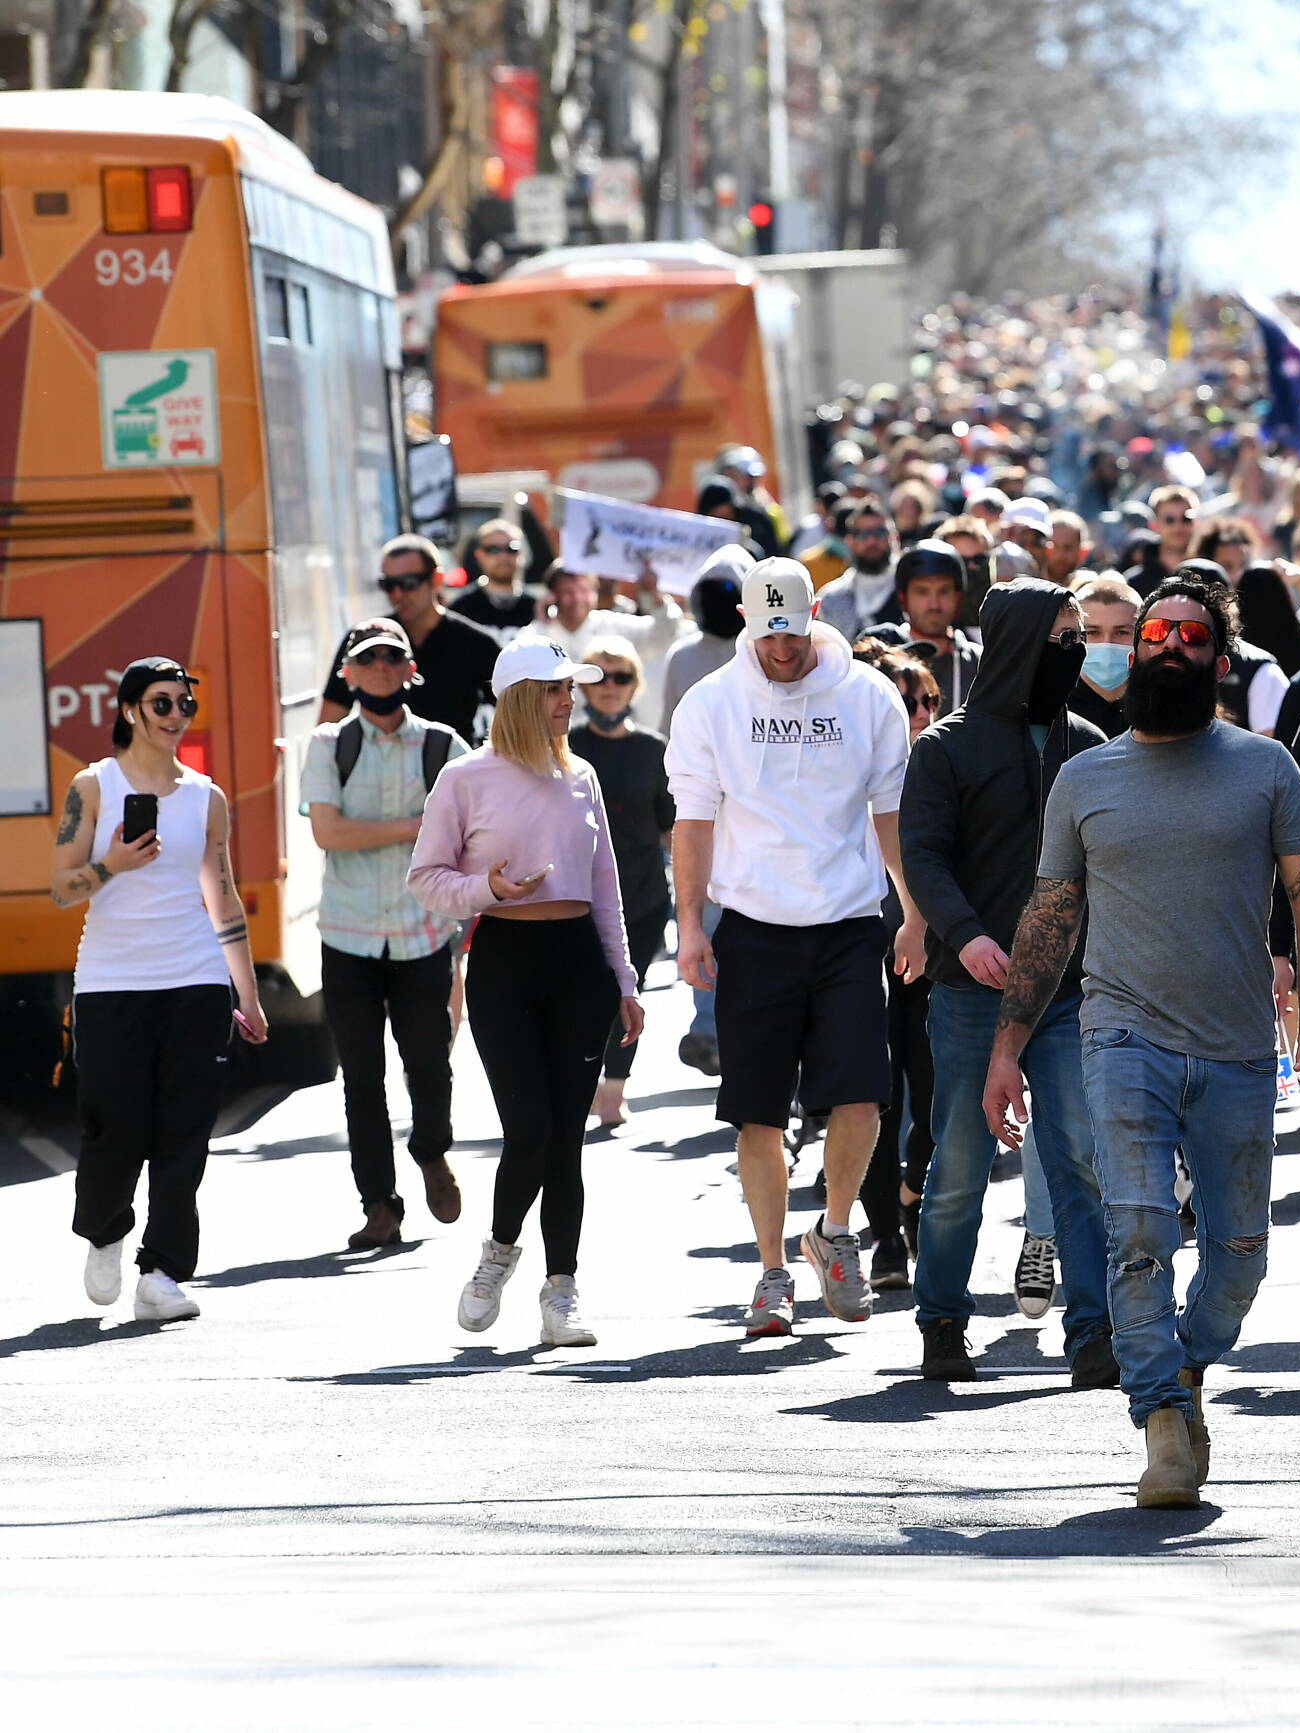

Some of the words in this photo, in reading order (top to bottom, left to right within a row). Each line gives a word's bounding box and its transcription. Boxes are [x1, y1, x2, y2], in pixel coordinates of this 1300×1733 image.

[94, 248, 174, 286] 934
[163, 396, 204, 410] GIVE
[166, 415, 202, 427] WAY
[765, 583, 784, 607] LA
[751, 716, 802, 734] NAVY
[811, 716, 841, 734] ST.
